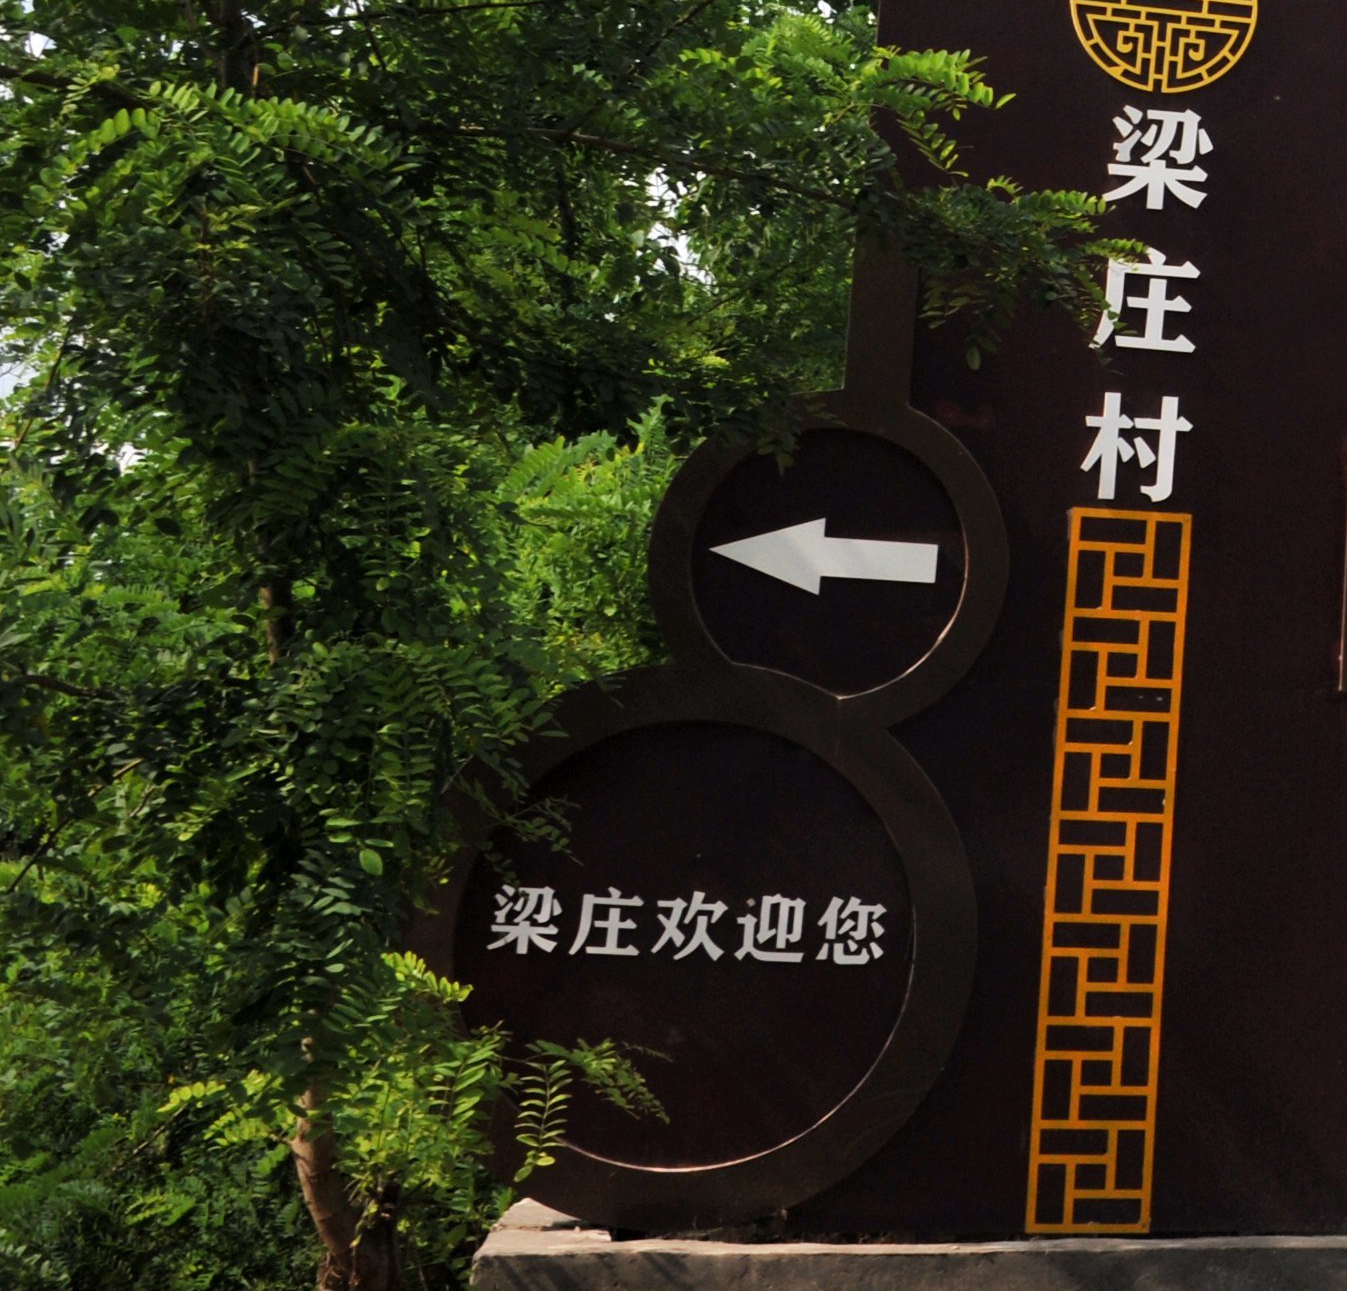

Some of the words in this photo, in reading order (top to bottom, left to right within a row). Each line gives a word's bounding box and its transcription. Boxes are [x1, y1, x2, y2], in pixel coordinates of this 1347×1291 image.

[1080, 104, 1214, 503] 梁庄村
[486, 884, 887, 966] 梁庄欢迎您
